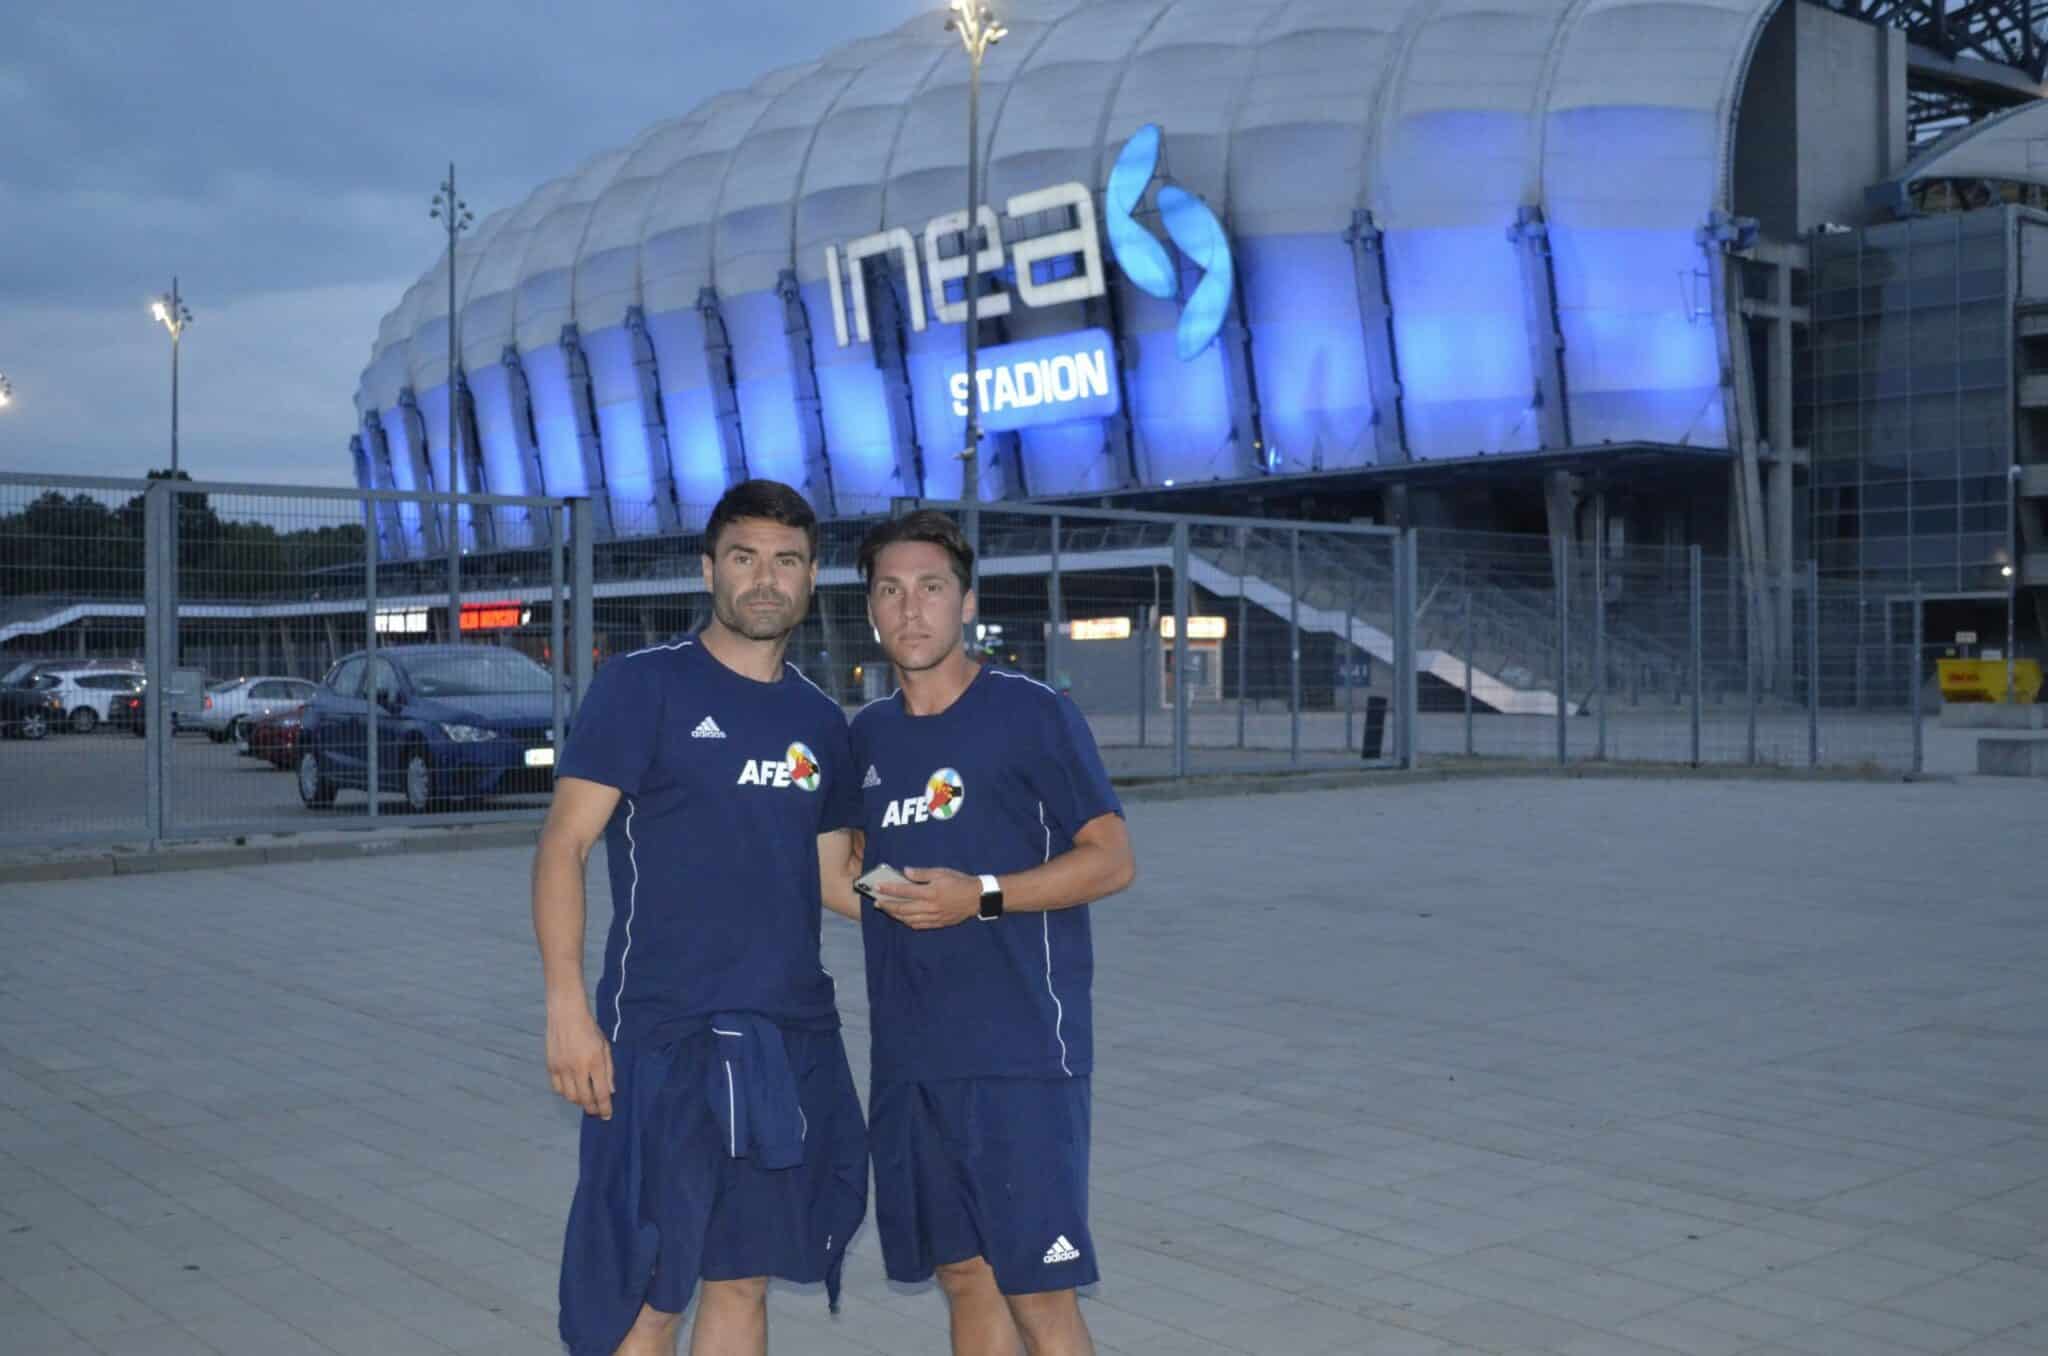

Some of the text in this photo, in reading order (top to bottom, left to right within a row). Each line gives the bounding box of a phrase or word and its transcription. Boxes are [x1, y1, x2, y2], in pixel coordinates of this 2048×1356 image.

[950, 349, 1109, 416] STADION
[737, 759, 793, 788] AFE
[881, 796, 931, 828] AFE
[1043, 1249, 1081, 1264] adidas
